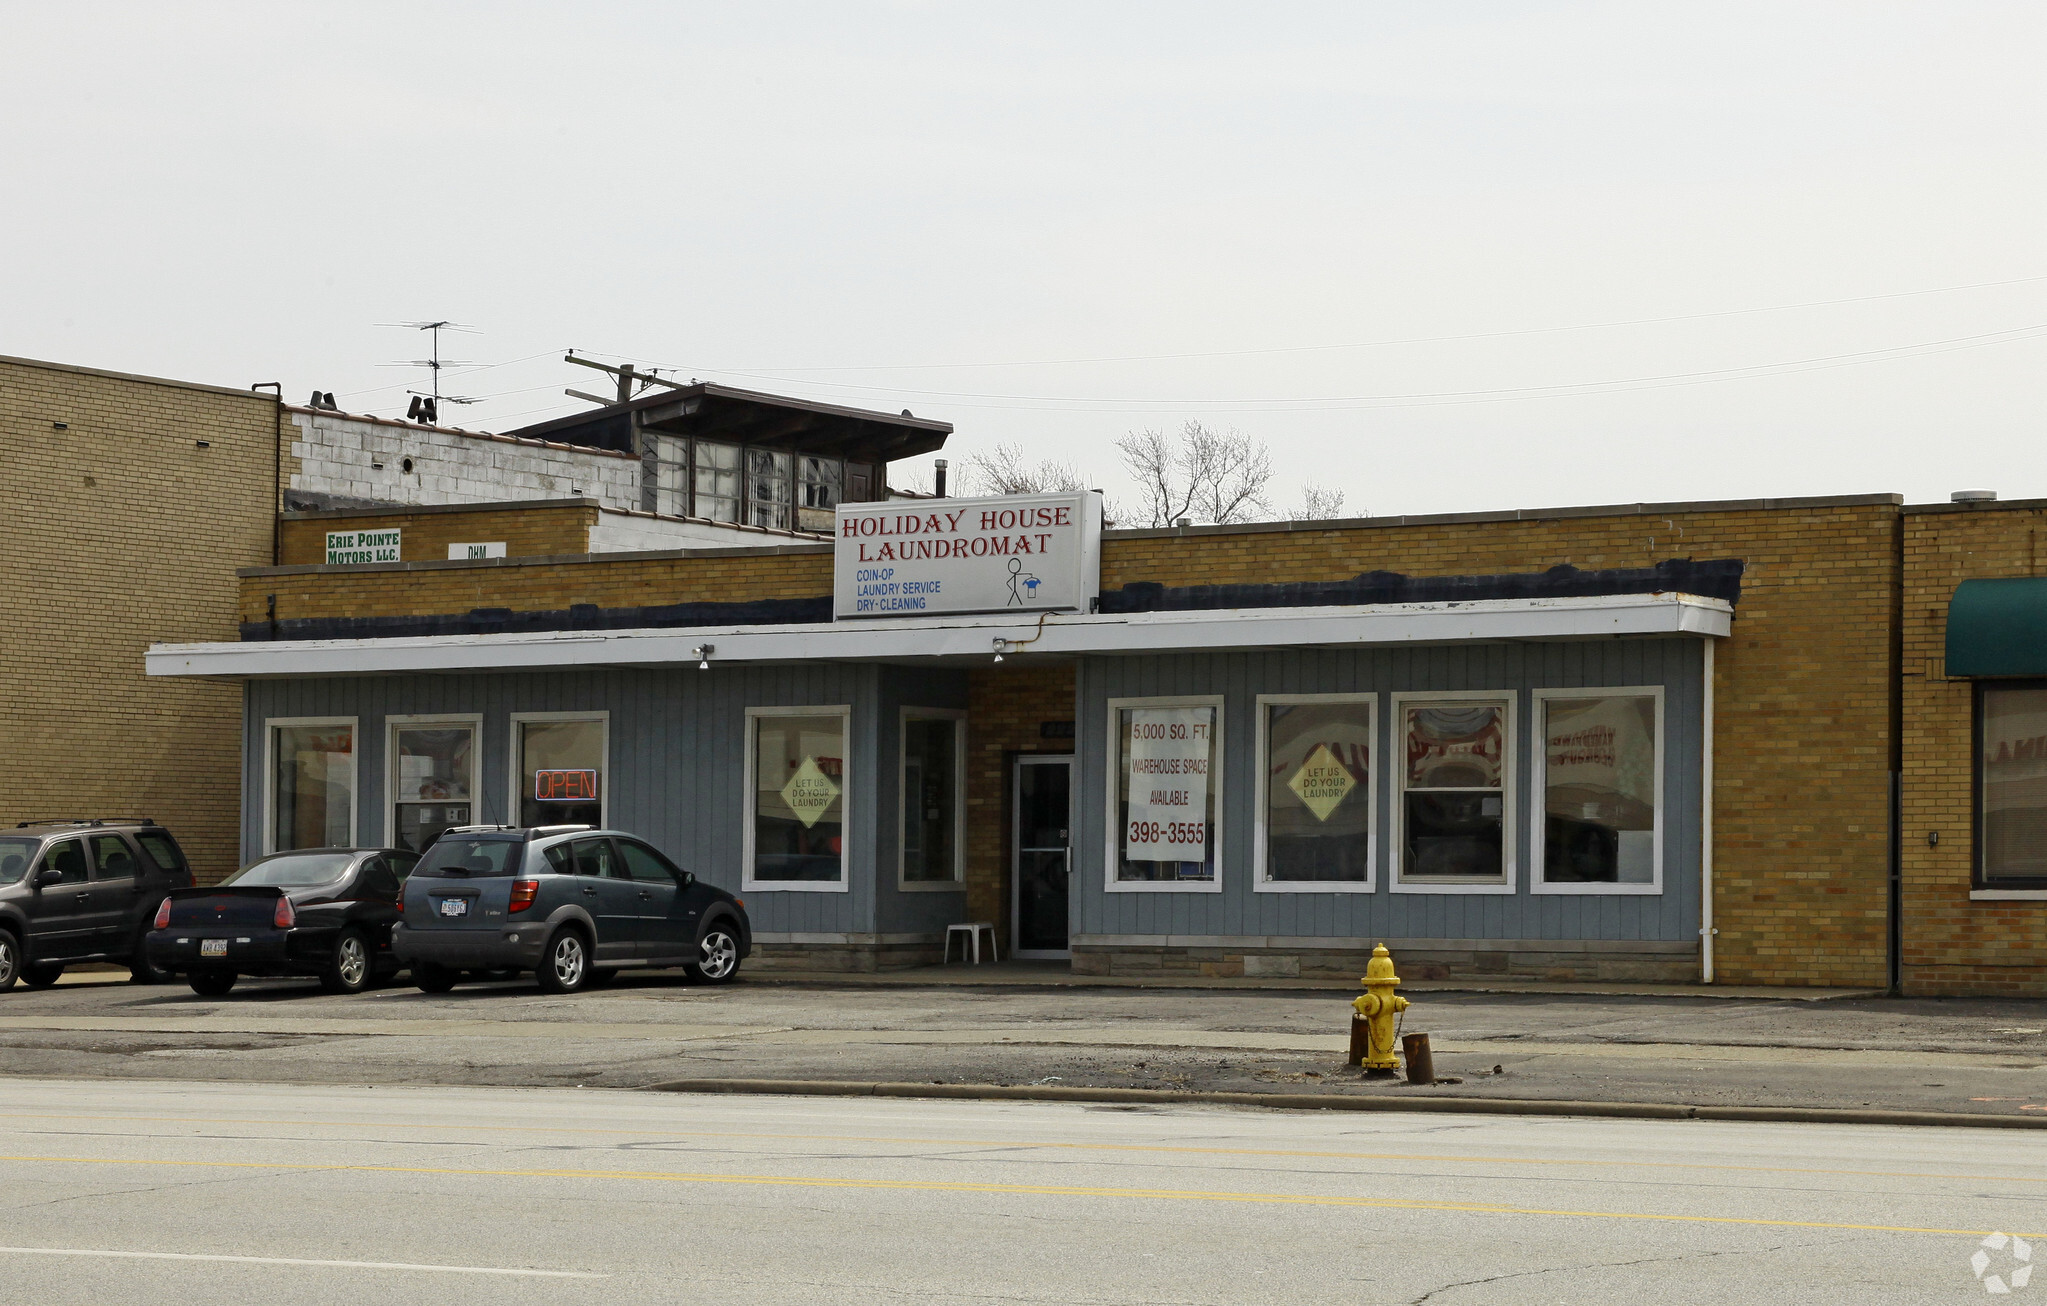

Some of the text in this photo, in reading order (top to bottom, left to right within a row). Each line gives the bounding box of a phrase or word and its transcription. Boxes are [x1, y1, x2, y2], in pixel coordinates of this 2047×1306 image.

[843, 507, 1072, 538] HOLIDAY HOUSE
[327, 533, 399, 549] ERIE POINTE
[858, 534, 1053, 562] LAUNDROMAT
[327, 549, 399, 564] MOTORS LLC.
[856, 568, 894, 582] COIN-OP
[857, 581, 941, 597] LAUNDRY SERVICE
[1133, 723, 1209, 740] 5,000 SQ. FT.
[1132, 758, 1207, 775] WAREHOUSE SPACE
[1308, 767, 1340, 777] LET US
[538, 771, 595, 798] OPEN
[796, 778, 824, 788] LET US
[1303, 778, 1346, 788] DO YOUR
[792, 788, 830, 797] DO YOUR
[1150, 790, 1189, 806] AVAILABLE
[1303, 788, 1345, 798] LAUNDRY
[792, 798, 829, 807] LAUNDRY
[1130, 821, 1204, 844] 398-3555
